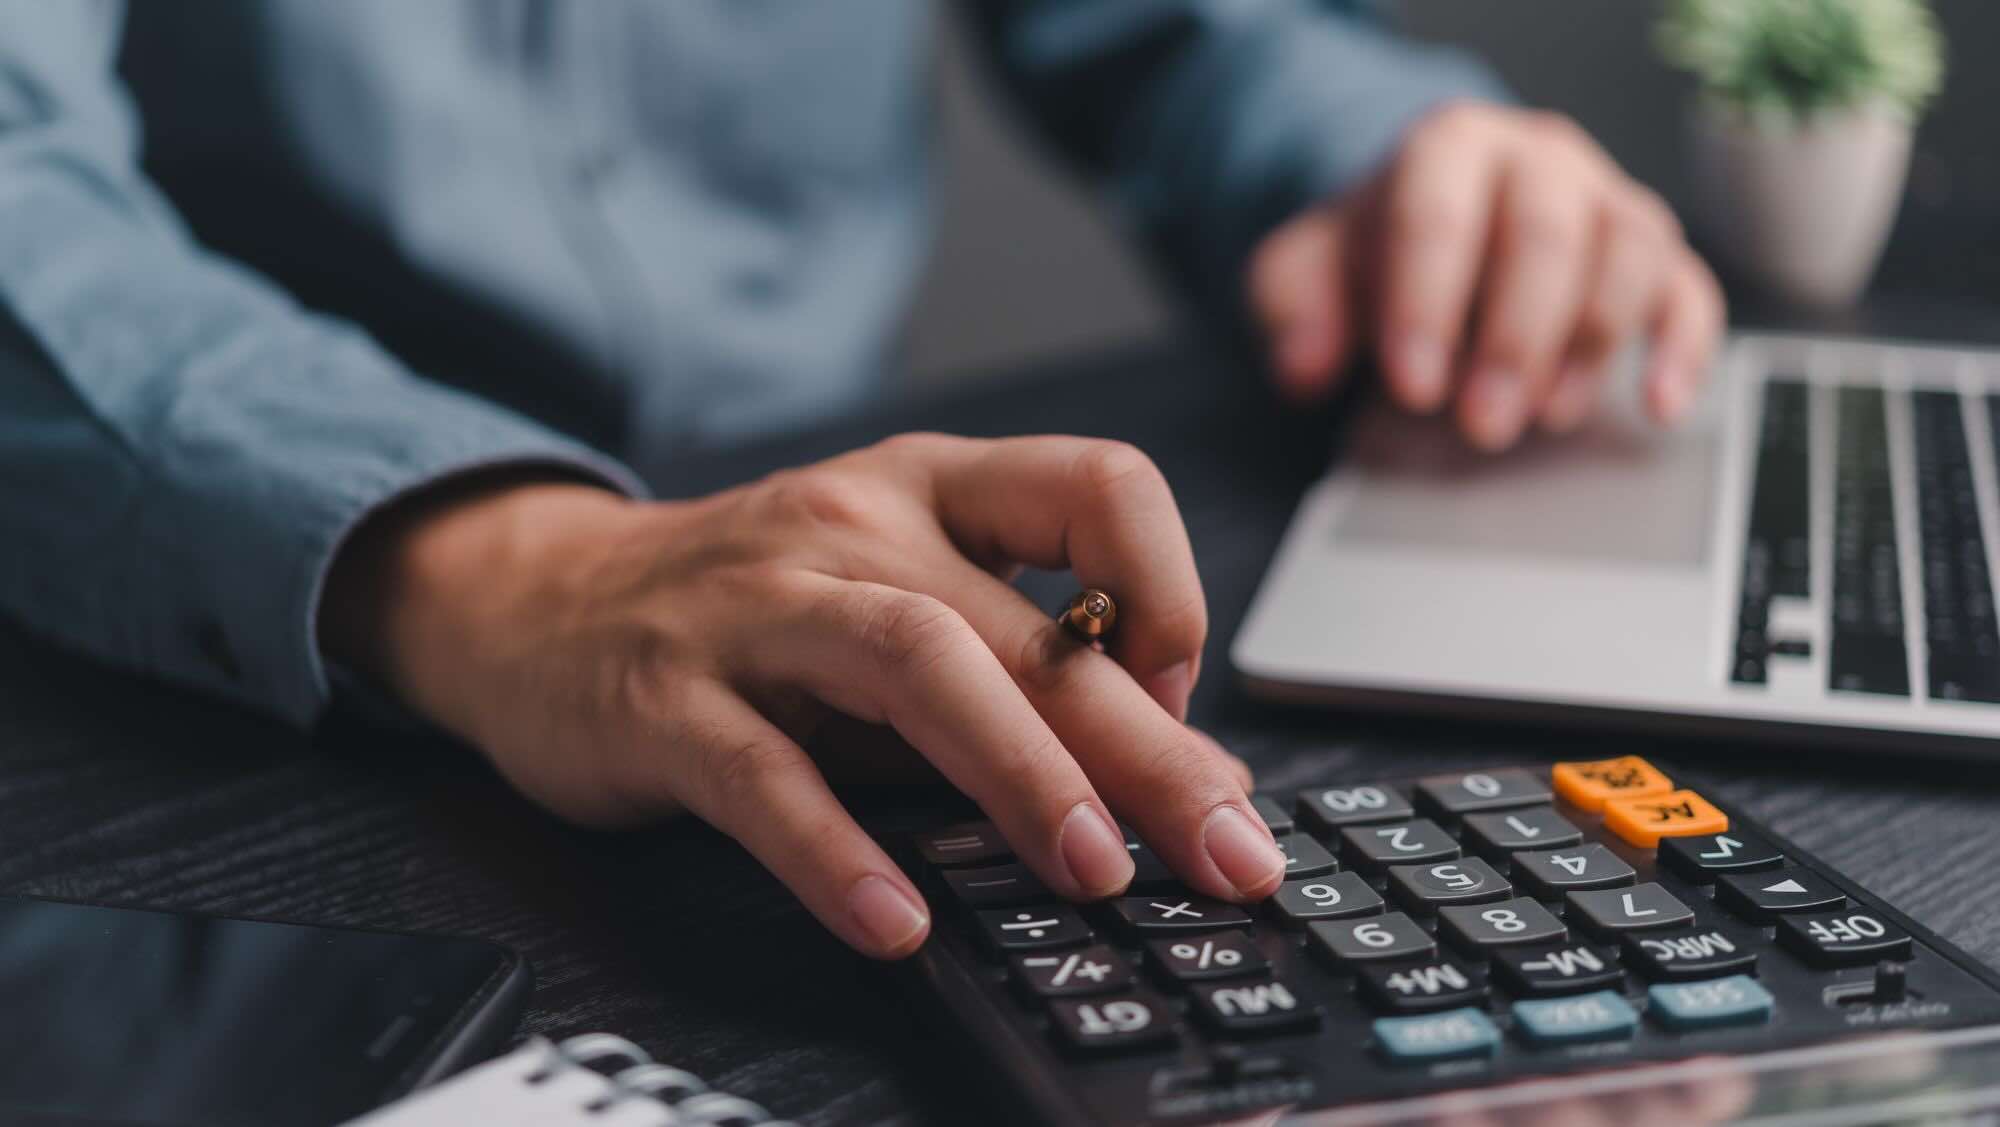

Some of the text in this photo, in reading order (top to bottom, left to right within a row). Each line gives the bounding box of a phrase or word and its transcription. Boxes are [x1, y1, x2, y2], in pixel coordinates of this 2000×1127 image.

[1463, 774, 1501, 796] 0
[1322, 786, 1388, 812] 00
[1505, 815, 1539, 837] 1
[1377, 827, 1424, 851] 2
[1431, 865, 1474, 888] 5
[1551, 854, 1587, 875] 4
[1301, 884, 1341, 906] 6
[1621, 893, 1657, 917] 7
[1481, 909, 1527, 932] 8
[1809, 915, 1885, 943] OFF
[1353, 923, 1395, 947] 9
[1639, 932, 1736, 962] MRC
[1170, 941, 1242, 969] %
[1386, 963, 1468, 994] M+
[1212, 982, 1297, 1016] MU
[1077, 1001, 1151, 1036] GT
